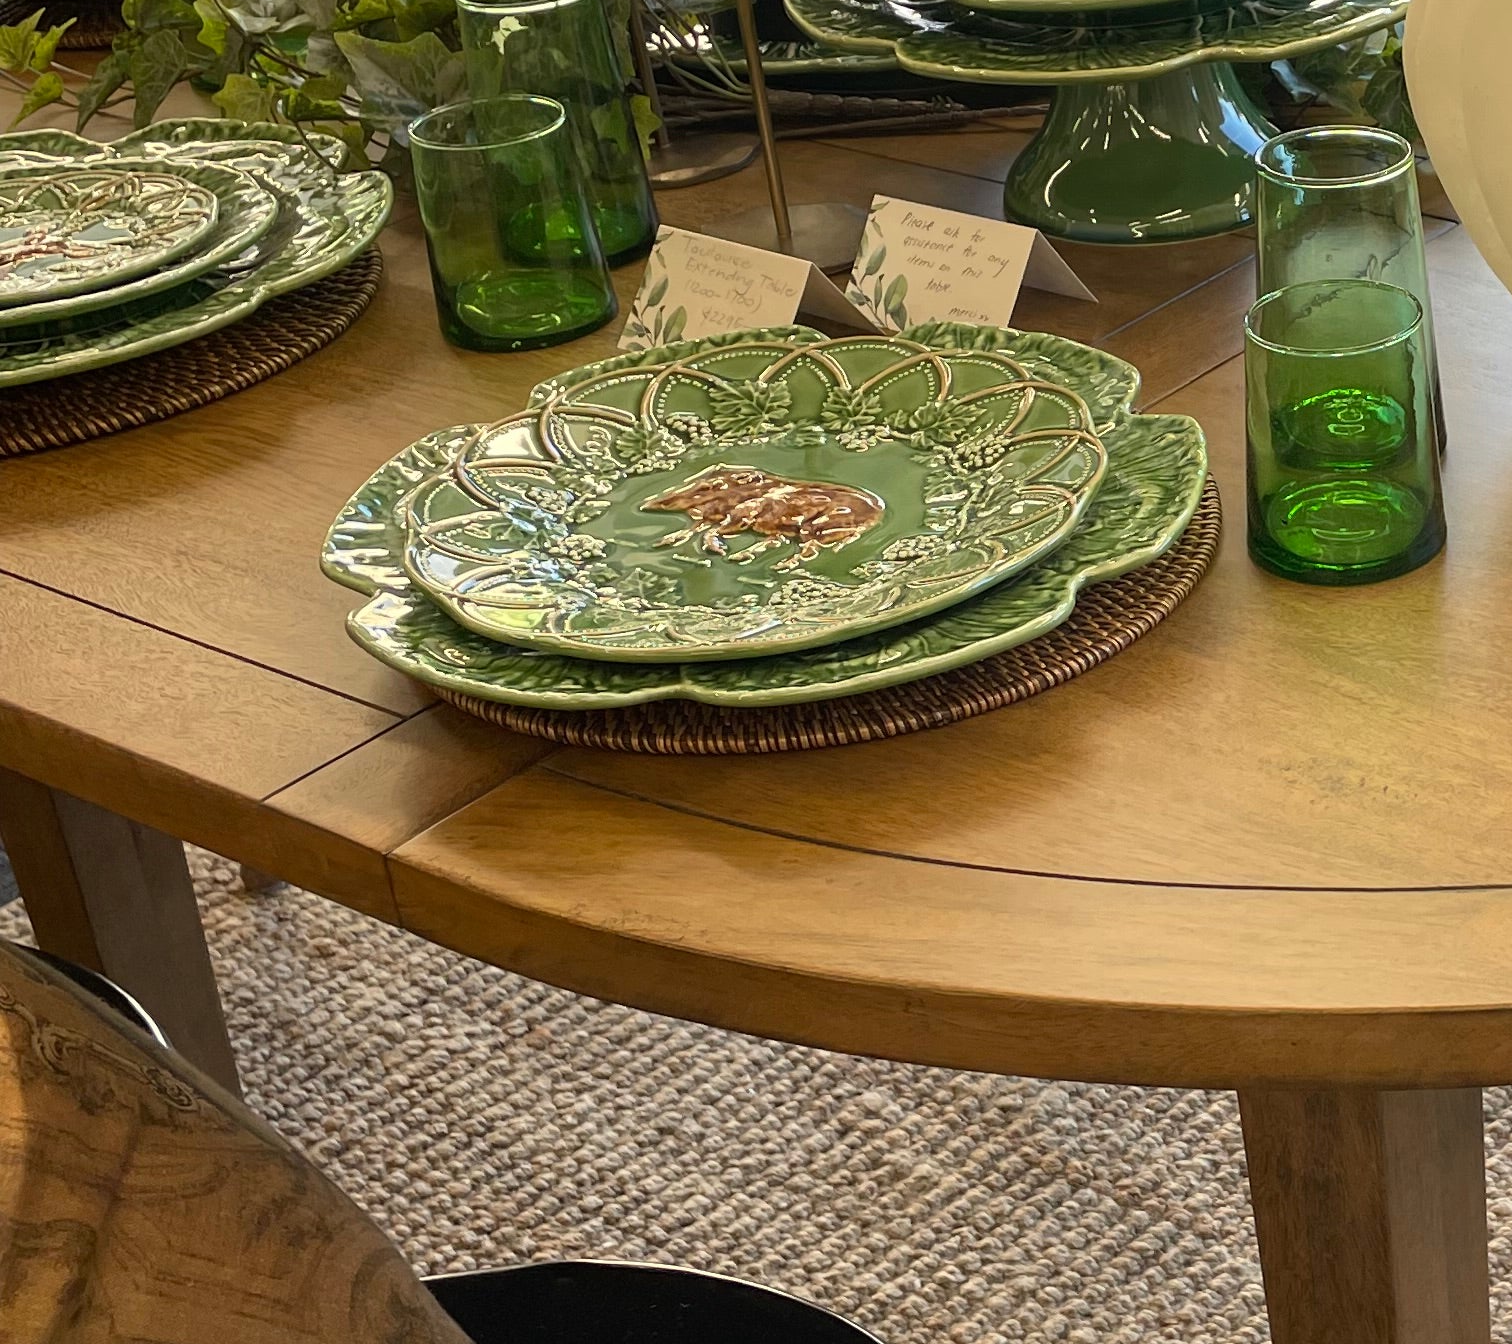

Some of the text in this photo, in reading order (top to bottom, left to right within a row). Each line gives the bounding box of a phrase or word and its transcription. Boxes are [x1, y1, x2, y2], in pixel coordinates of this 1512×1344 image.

[901, 212, 985, 243] Please ask for
[685, 257, 797, 297] Extending Table
[988, 255, 1009, 278] any
